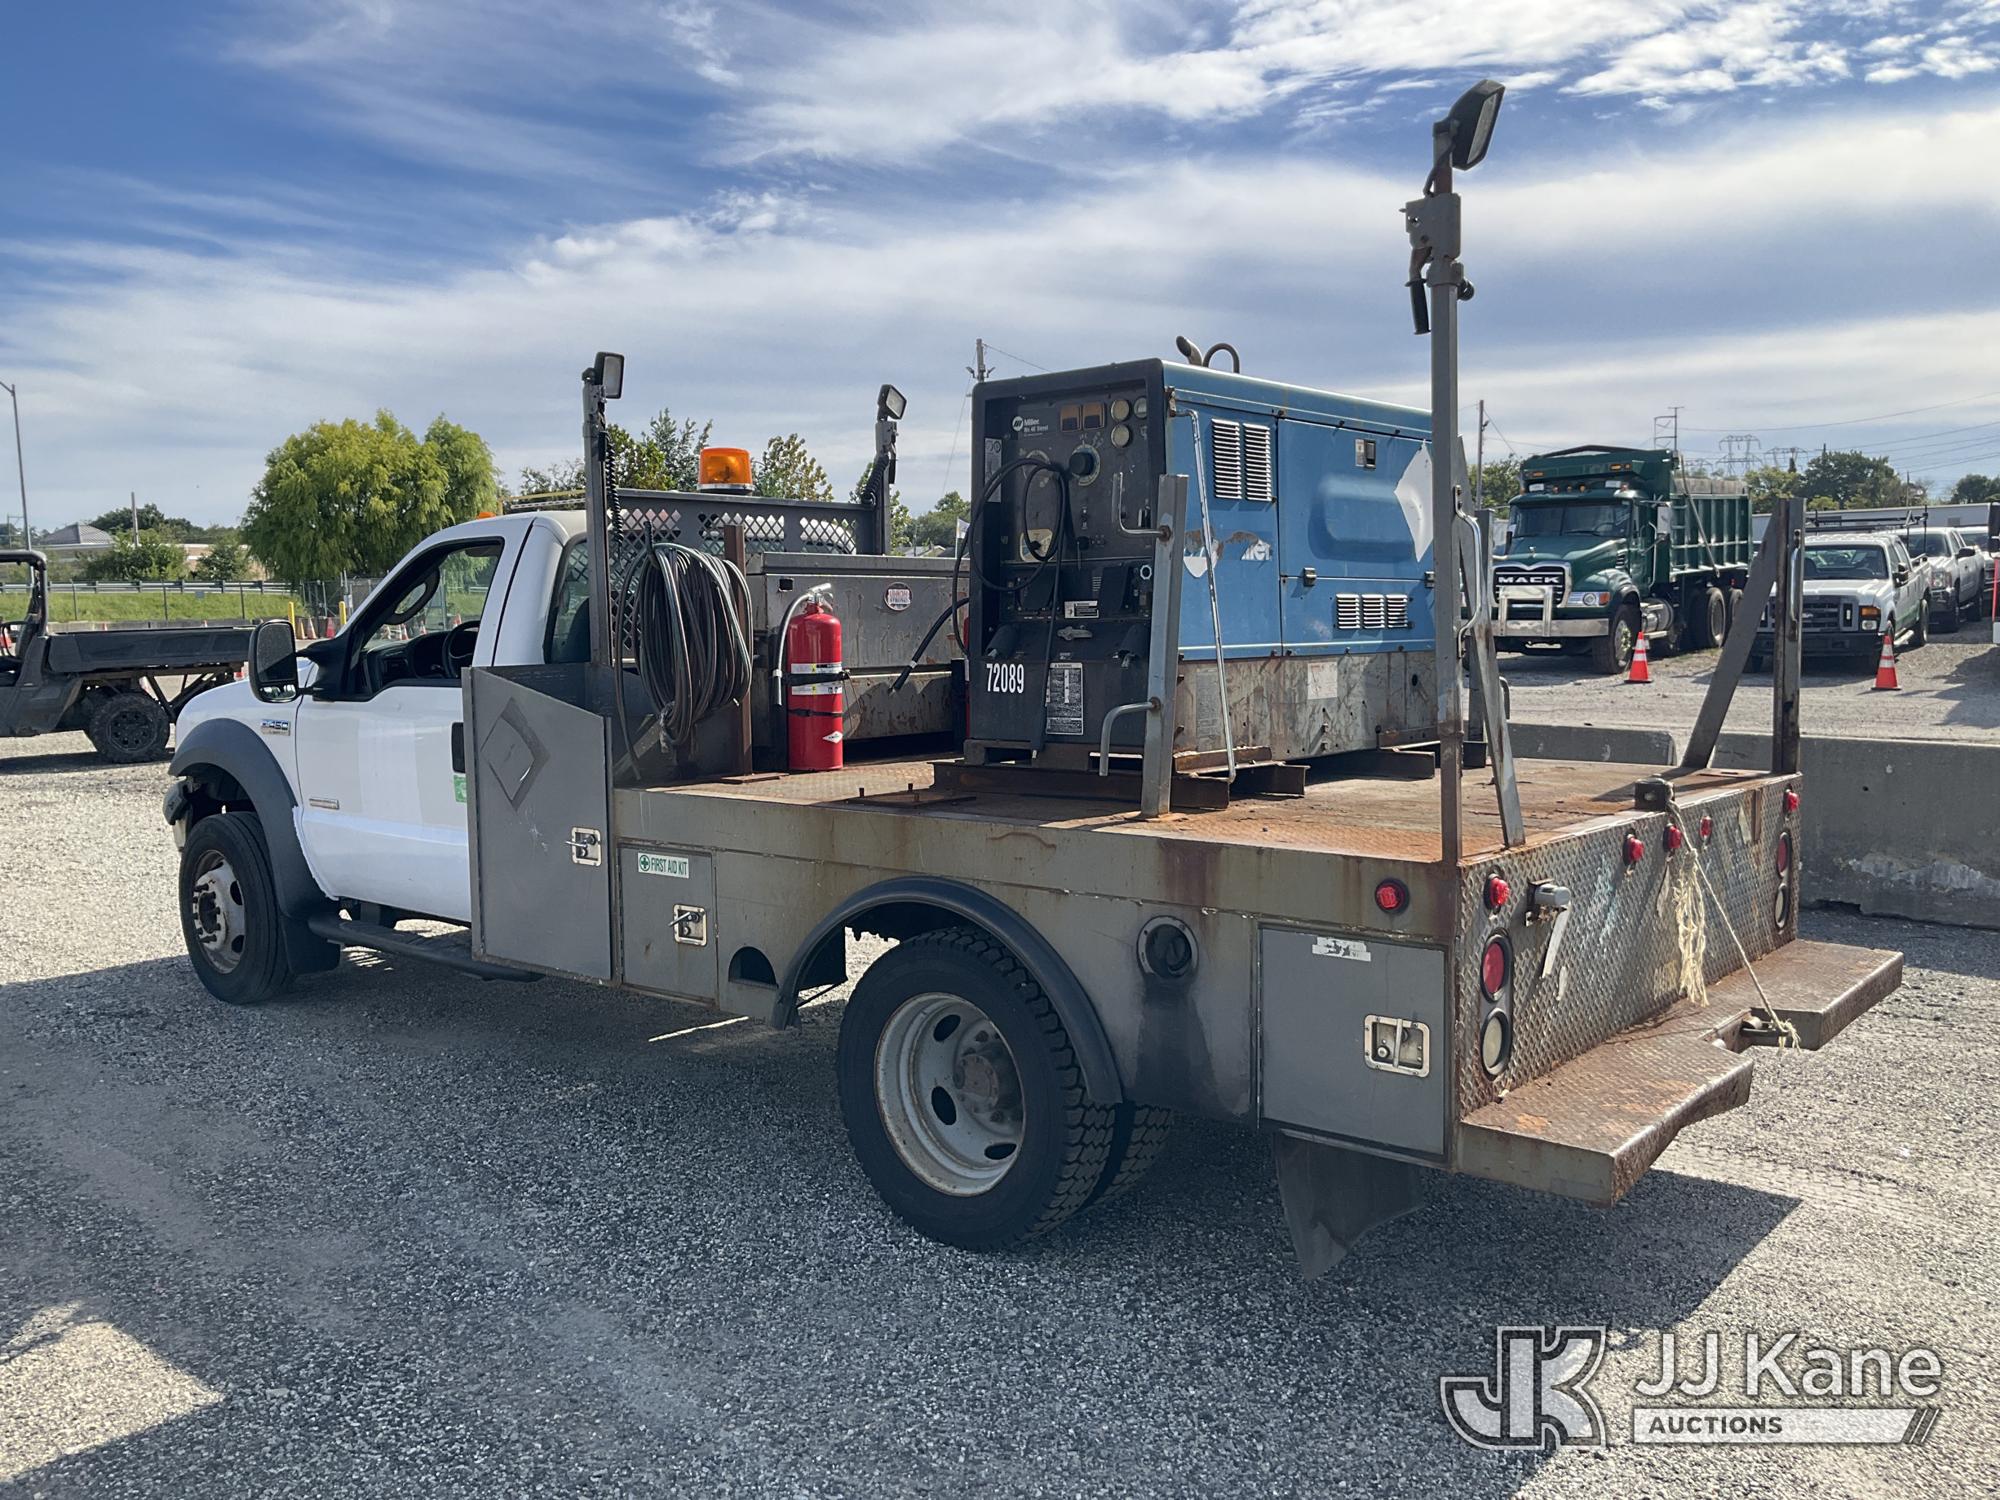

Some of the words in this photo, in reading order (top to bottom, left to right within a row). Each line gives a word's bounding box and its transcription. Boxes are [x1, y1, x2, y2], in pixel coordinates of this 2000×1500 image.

[1498, 576, 1560, 584] MACK
[986, 663, 1024, 693] 72089
[651, 857, 667, 873] FIRST
[667, 859, 678, 874] AID
[678, 861, 688, 876] KIT
